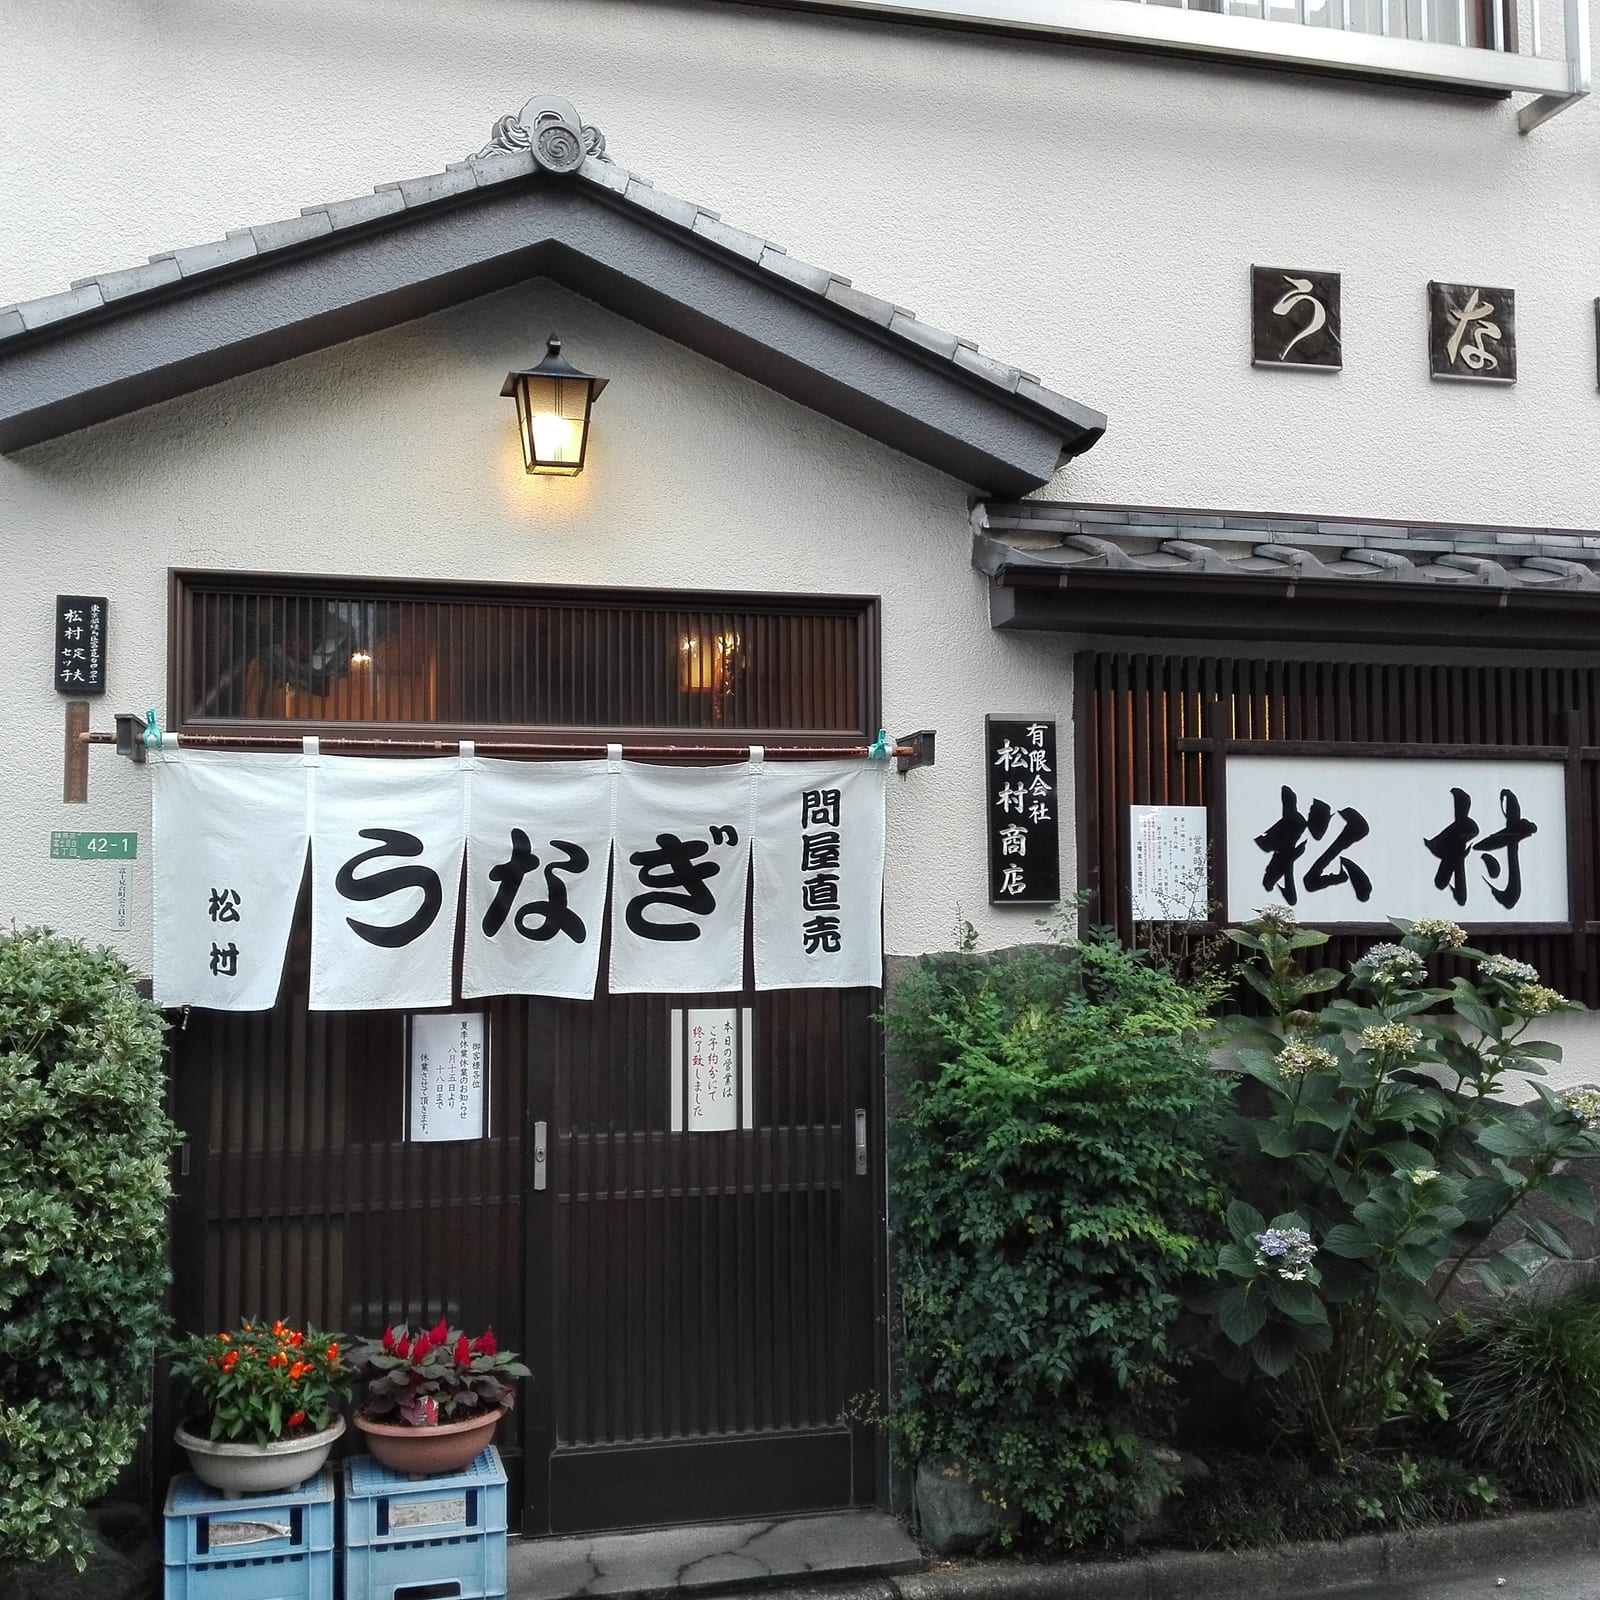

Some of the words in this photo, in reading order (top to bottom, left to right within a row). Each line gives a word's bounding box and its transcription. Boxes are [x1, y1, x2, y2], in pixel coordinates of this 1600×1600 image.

[63, 609, 84, 640] 松村
[994, 738, 1029, 896] 松村商店
[1026, 723, 1052, 824] 有限会社
[53, 848, 77, 857] 4丁目
[87, 838, 128, 853] 42-1
[335, 825, 738, 948] うなぎ
[801, 788, 841, 955] 問屋直売
[1253, 784, 1538, 909] 松村
[209, 887, 241, 977] 松村
[435, 1064, 445, 1110] 十八日まで
[692, 1025, 705, 1117] 終了致しました
[723, 1020, 734, 1098] 本日の営業は
